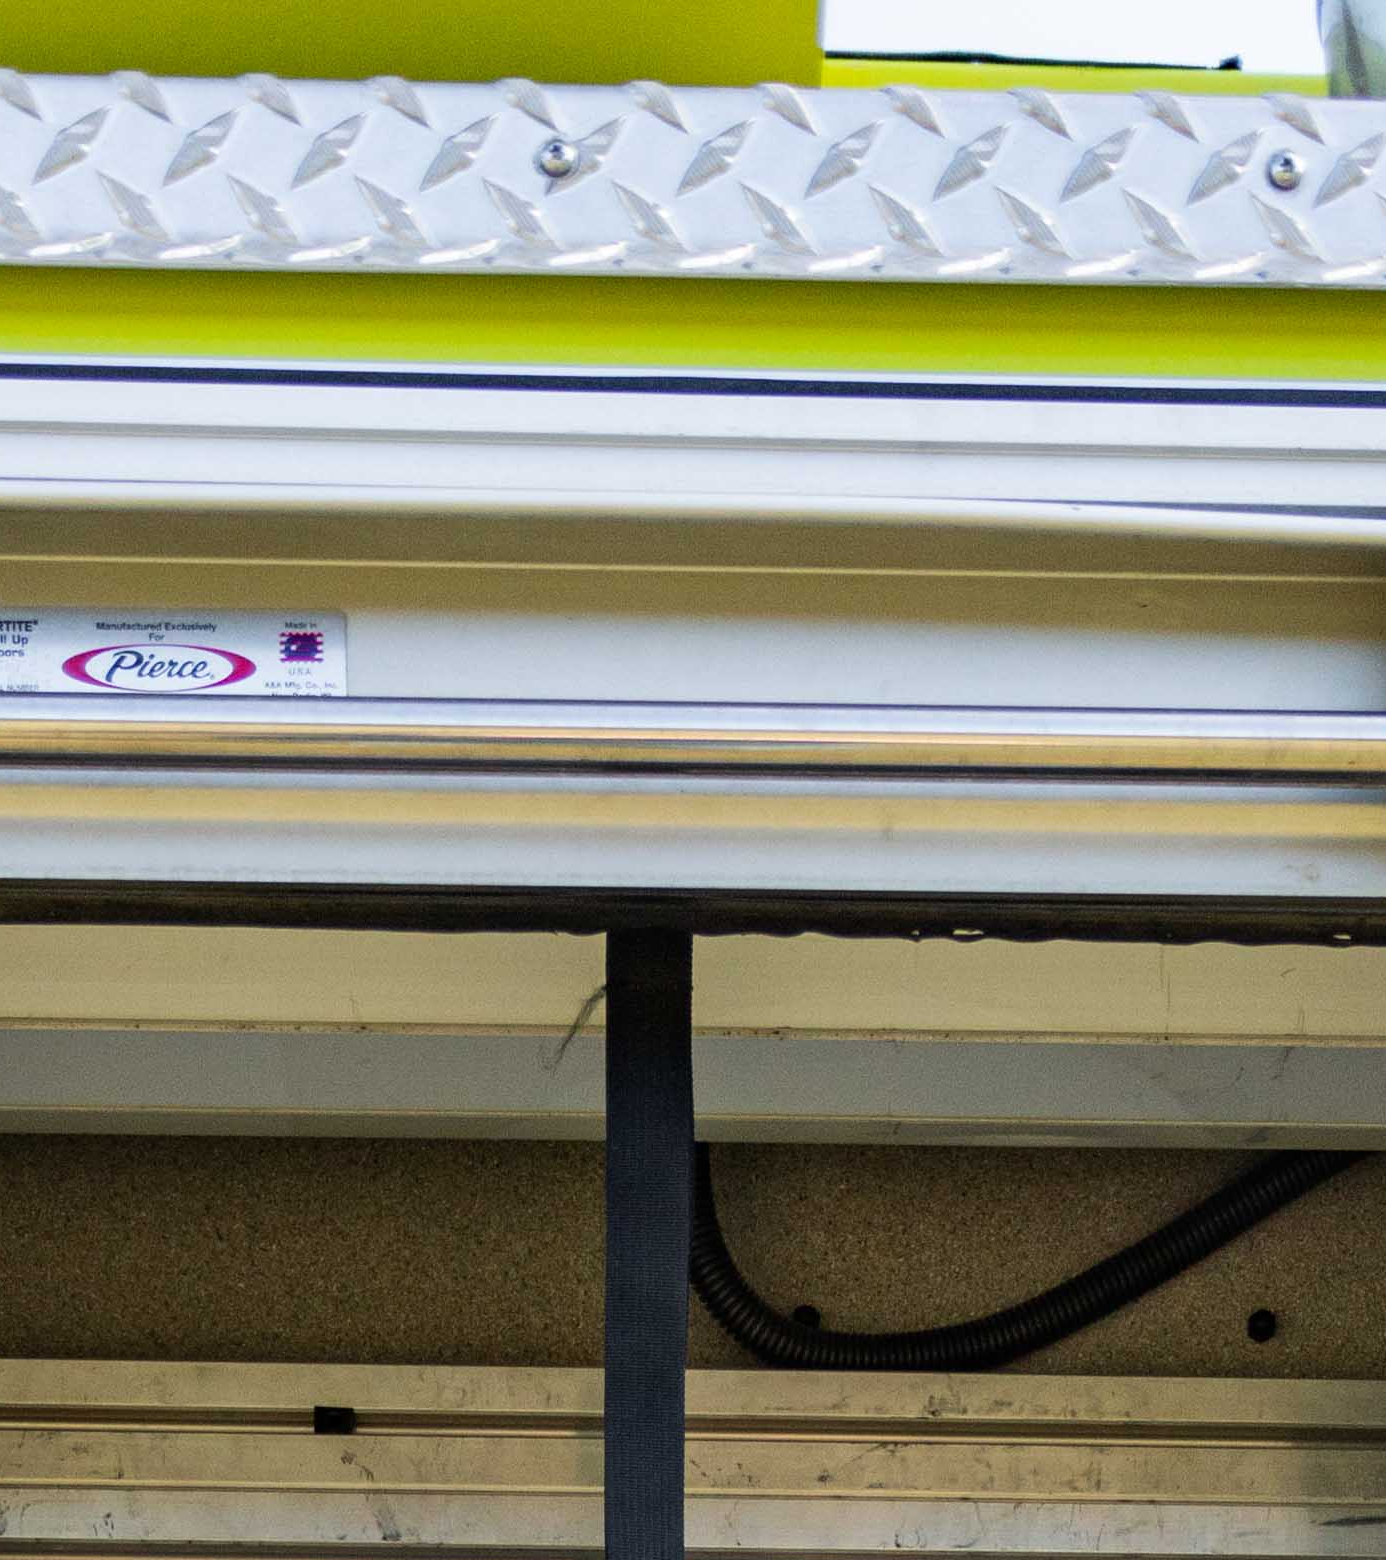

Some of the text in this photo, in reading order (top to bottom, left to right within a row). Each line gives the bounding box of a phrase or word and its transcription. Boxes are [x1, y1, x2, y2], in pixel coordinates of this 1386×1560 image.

[96, 622, 217, 632] Manufactured Exclusively
[12, 634, 29, 648] Up
[149, 633, 165, 641] For
[105, 650, 212, 683] Pierce
